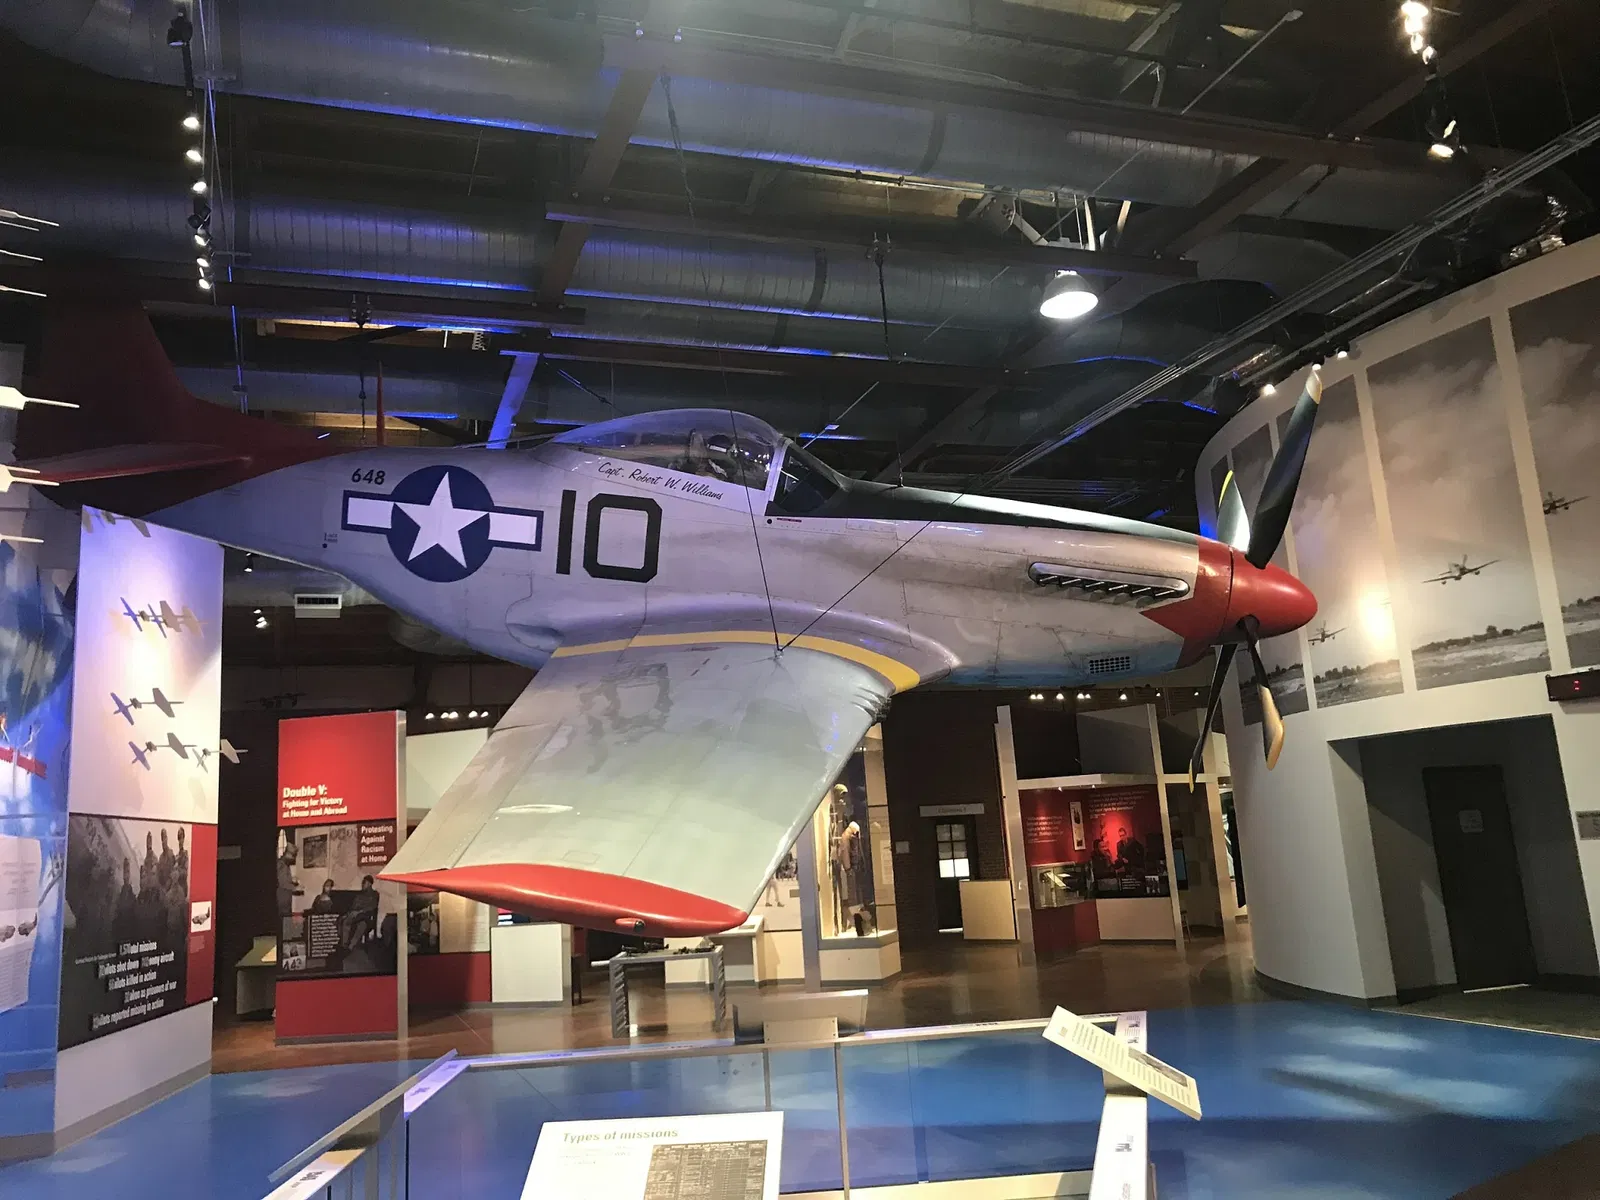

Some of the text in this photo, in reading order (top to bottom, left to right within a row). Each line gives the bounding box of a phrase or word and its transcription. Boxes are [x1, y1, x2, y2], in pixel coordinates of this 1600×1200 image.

[351, 468, 386, 485] 648
[598, 462, 724, 500] Capt. Robert W. Williams
[556, 489, 662, 583] 10
[283, 784, 328, 798] Double V:
[283, 797, 343, 809] Fighting for Victory
[282, 806, 348, 818] at Home and Abroad
[361, 825, 393, 835] Protesting
[361, 835, 385, 845] Against
[361, 846, 385, 854] Racism
[368, 854, 388, 863] Home
[563, 1129, 679, 1144] Types of missions
